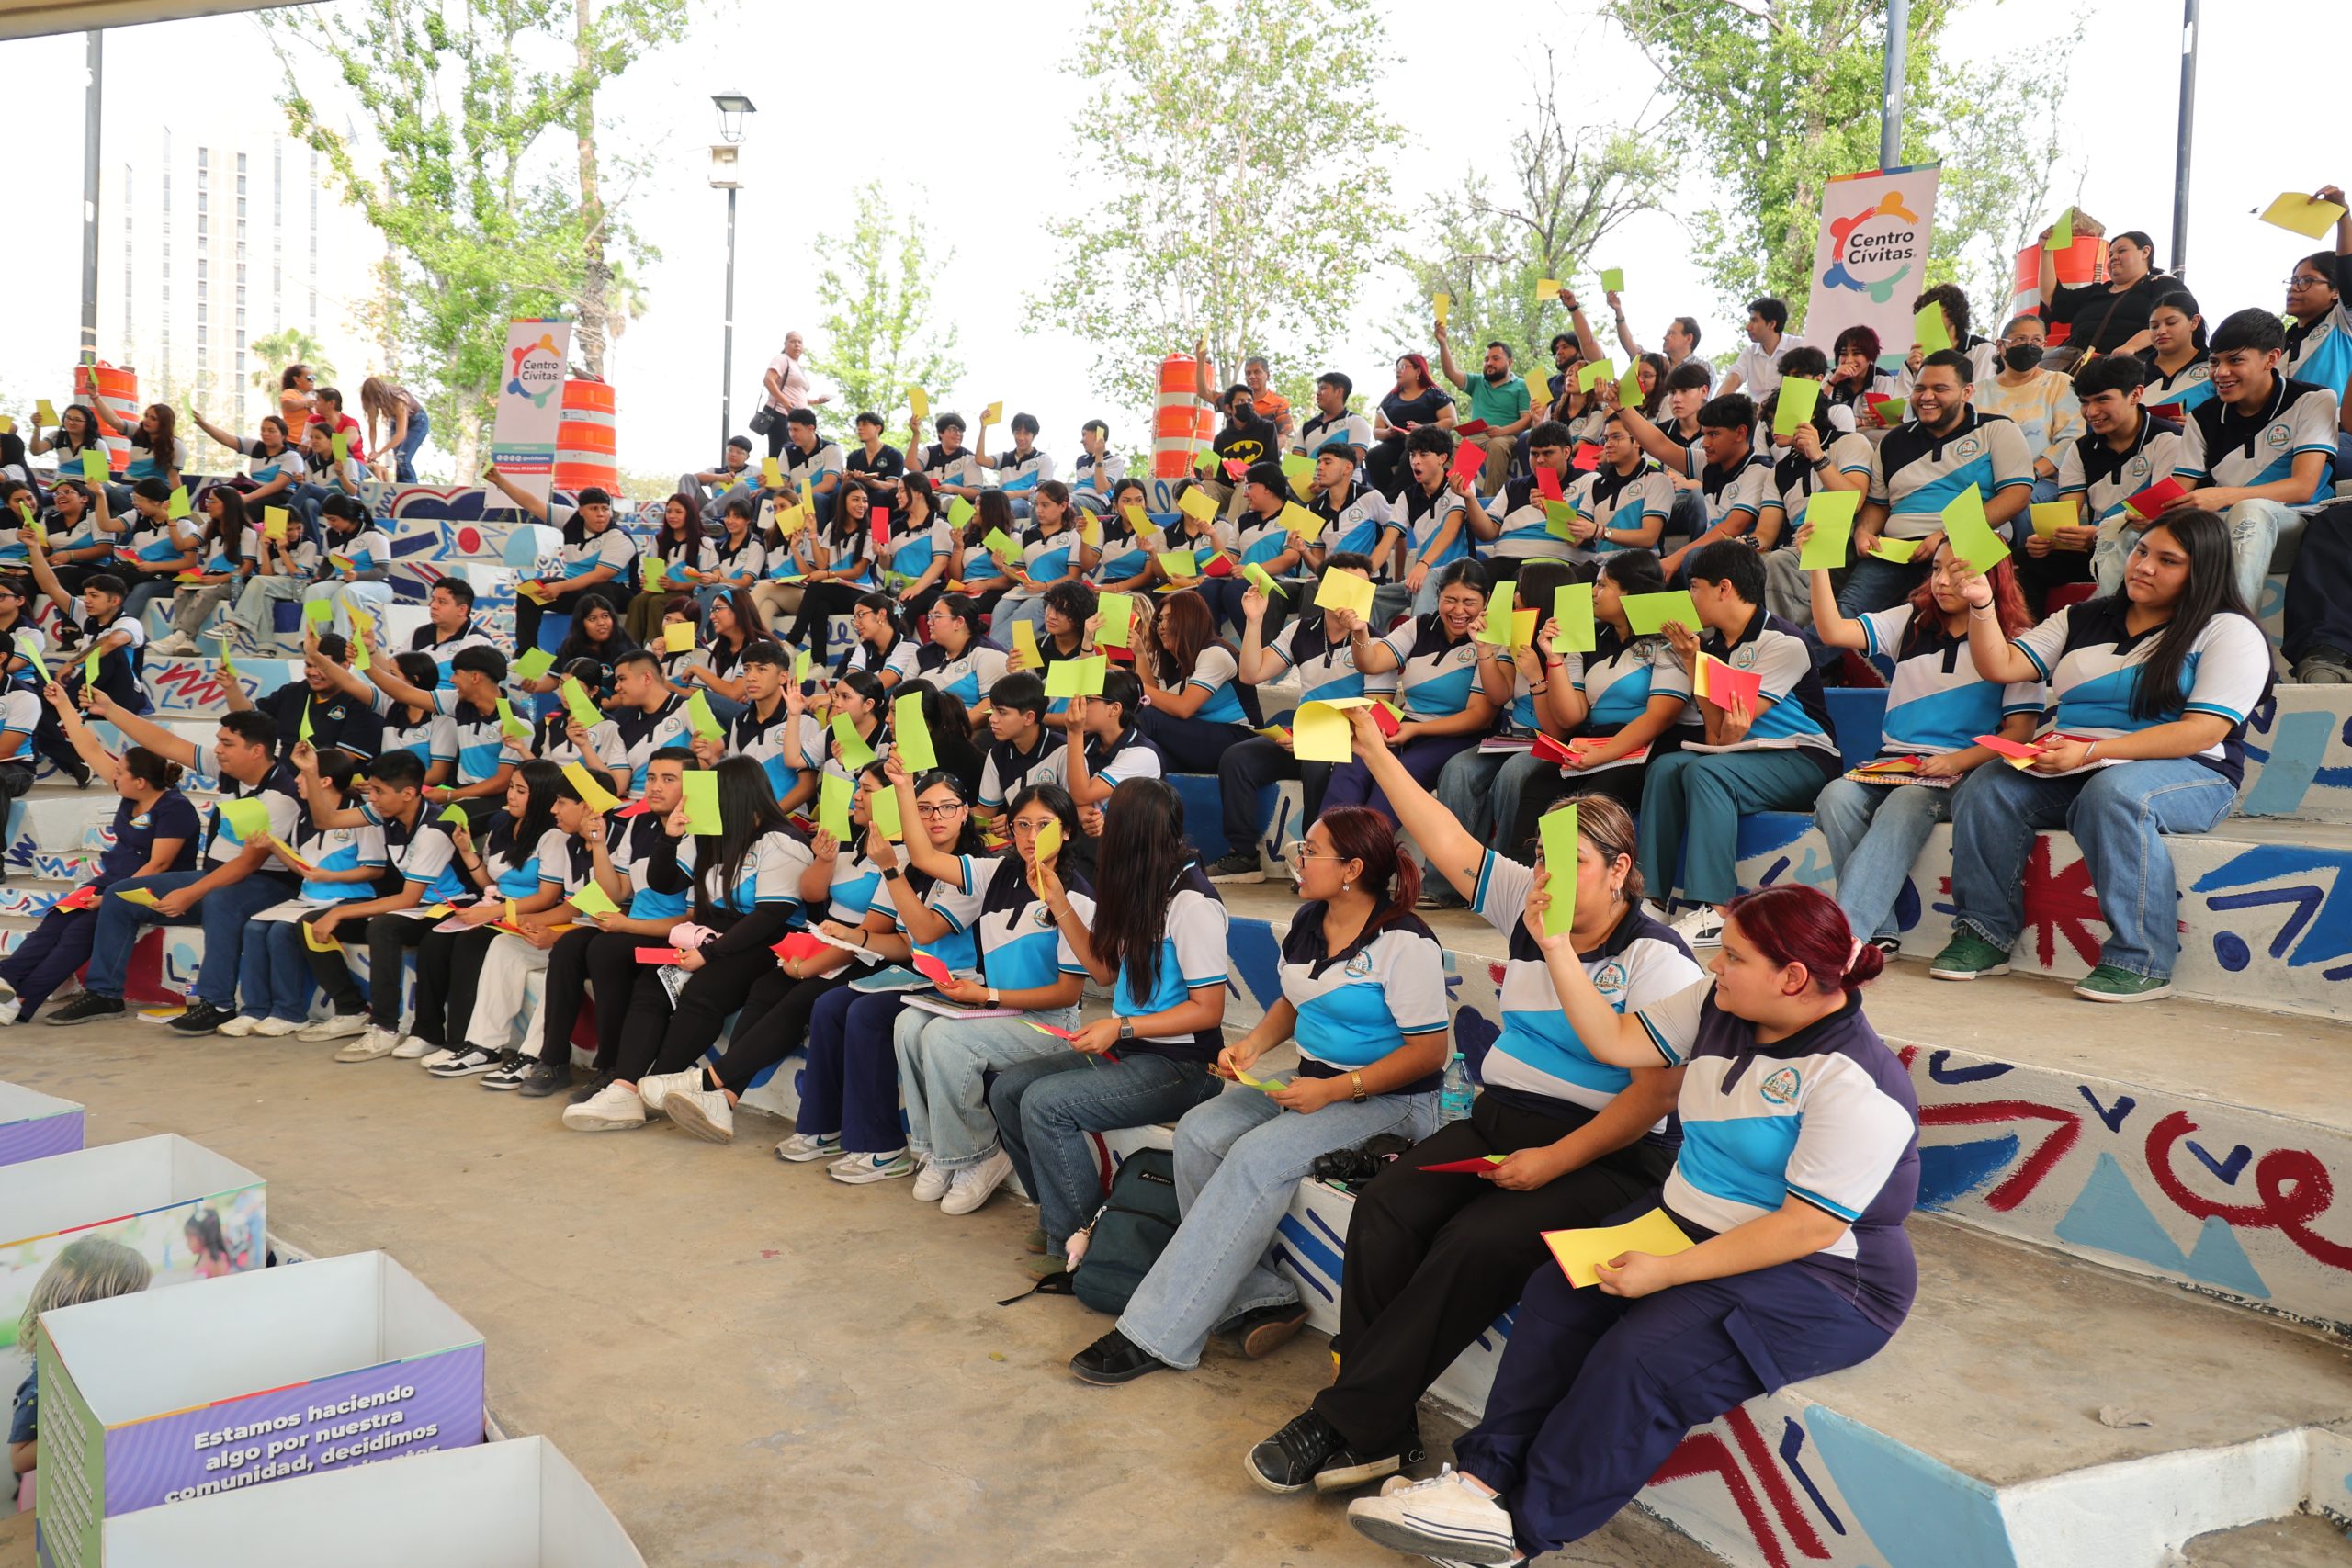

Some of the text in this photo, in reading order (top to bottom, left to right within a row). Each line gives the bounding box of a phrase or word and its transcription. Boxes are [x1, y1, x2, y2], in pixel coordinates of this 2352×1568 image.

[1849, 246, 1913, 265] Cívitas
[1850, 231, 1914, 248] Centro
[524, 360, 559, 369] Centro
[194, 1384, 414, 1450] Estamos haciendo
[205, 1409, 404, 1472] algo por nuestra
[164, 1454, 314, 1504] comunidad,
[320, 1423, 438, 1463] decidimos
